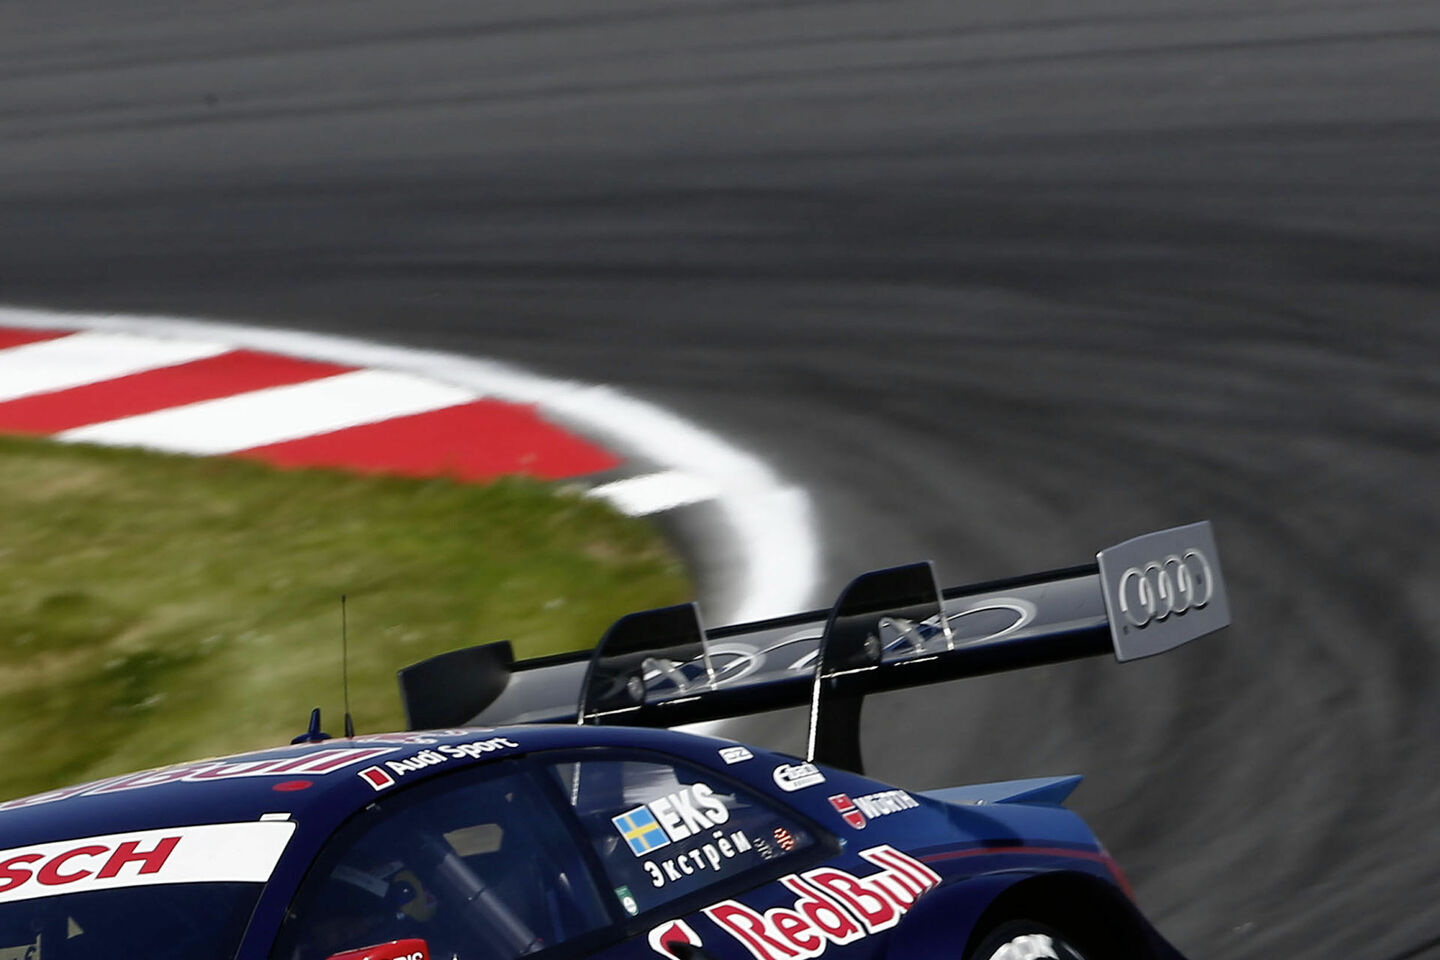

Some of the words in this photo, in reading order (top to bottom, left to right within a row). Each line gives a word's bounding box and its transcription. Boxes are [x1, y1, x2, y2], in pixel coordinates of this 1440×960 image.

[385, 748, 449, 776] Audi
[438, 736, 520, 759] Sport
[649, 783, 729, 843] EKS
[643, 830, 753, 888] Экстрём
[800, 844, 943, 935] Bull
